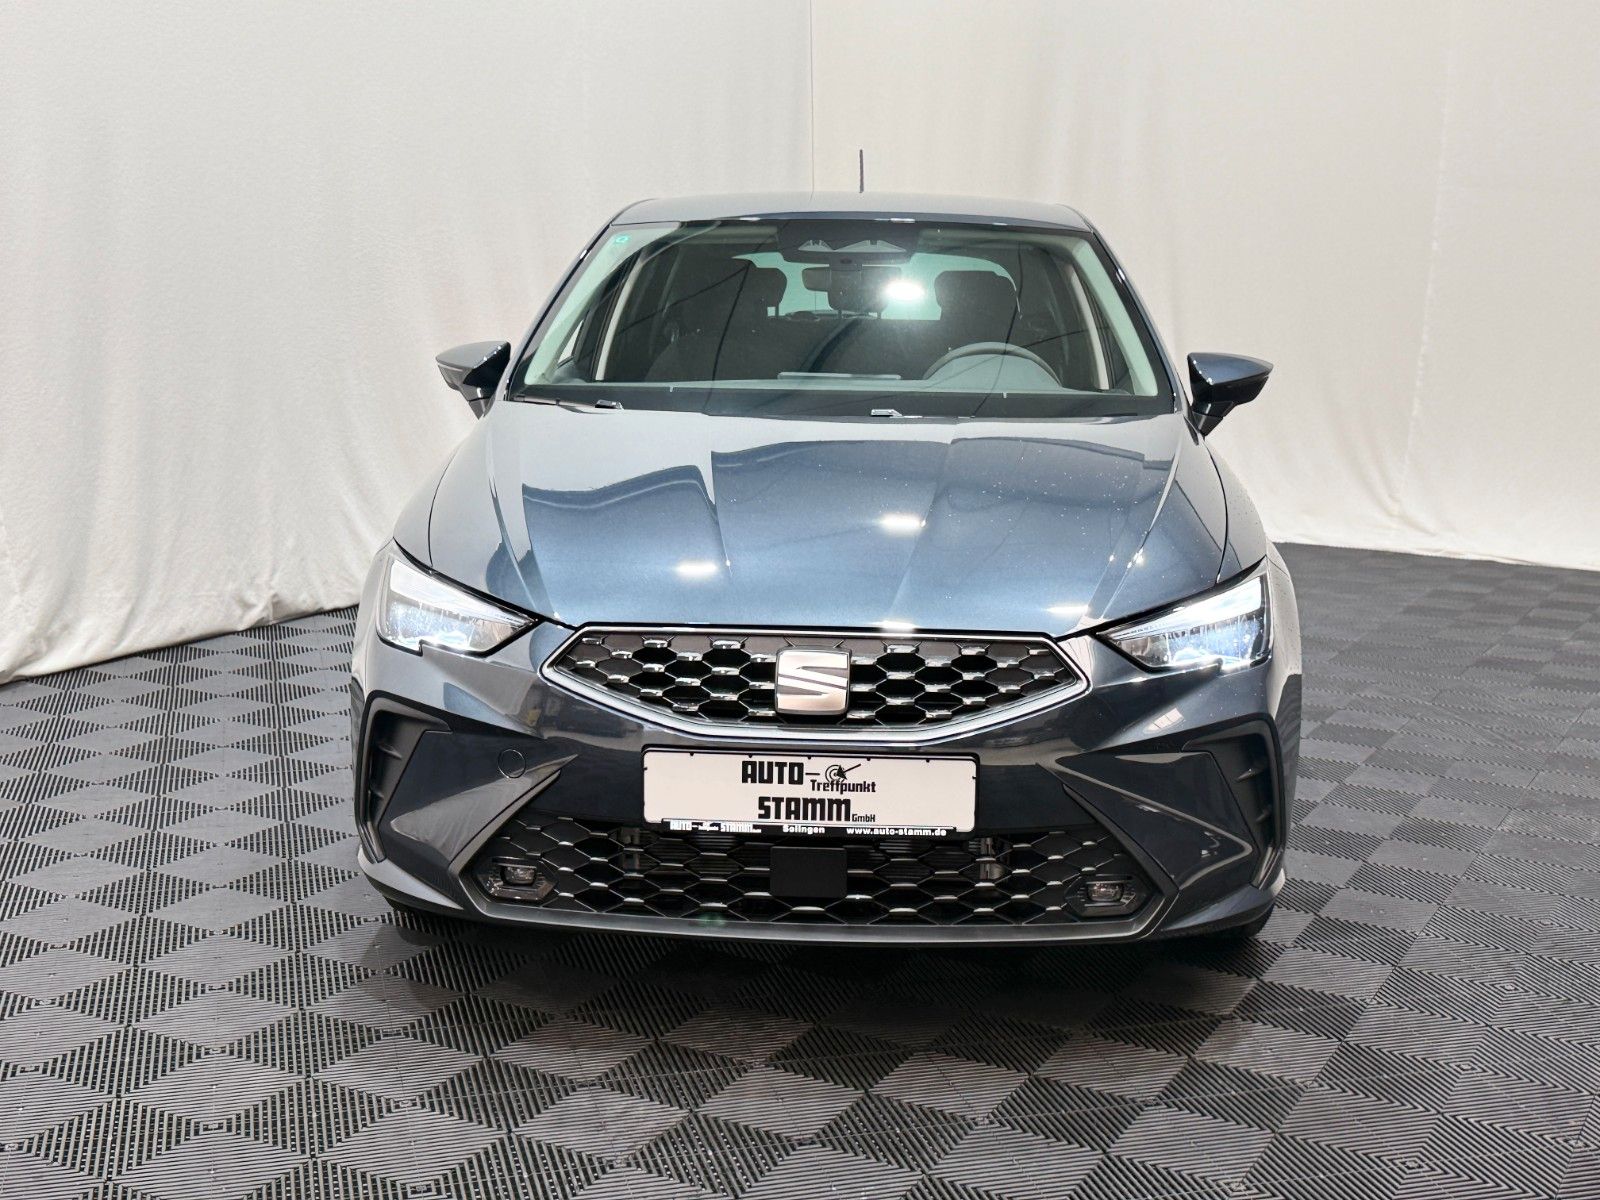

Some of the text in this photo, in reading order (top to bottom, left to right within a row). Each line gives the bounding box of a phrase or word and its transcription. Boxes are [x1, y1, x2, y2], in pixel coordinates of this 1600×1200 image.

[810, 779, 876, 795] Treffpunkt
[758, 796, 876, 823] STAMM GmbH
[783, 824, 947, 837] Solingen www.auto-stamm.de
